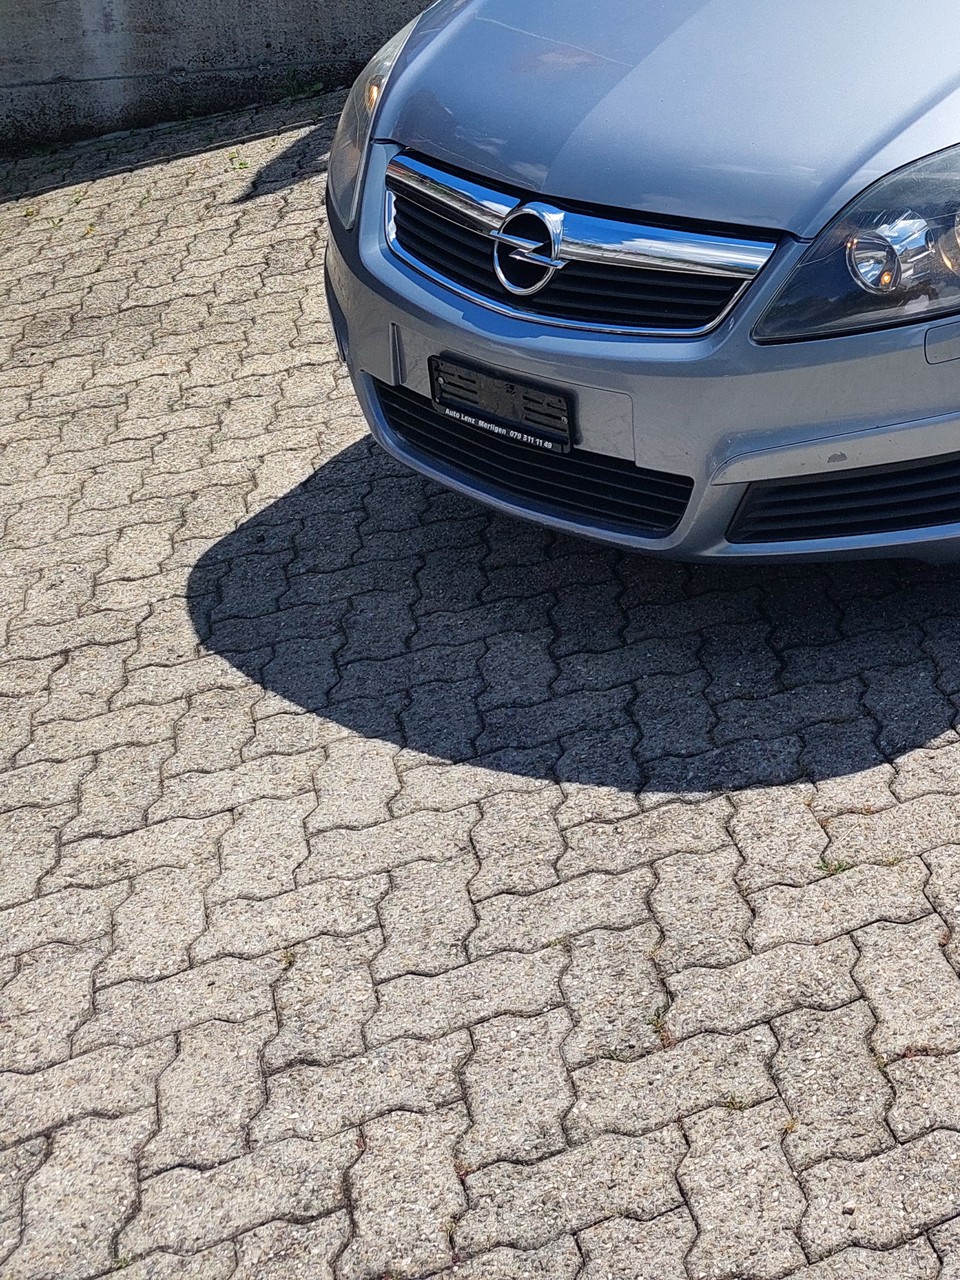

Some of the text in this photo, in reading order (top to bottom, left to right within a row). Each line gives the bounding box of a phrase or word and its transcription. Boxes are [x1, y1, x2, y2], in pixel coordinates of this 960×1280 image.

[445, 408, 460, 419] Auto
[461, 413, 476, 425] Lenz
[478, 420, 507, 435] Merligen
[509, 430, 522, 440] 079
[523, 434, 535, 444] 311
